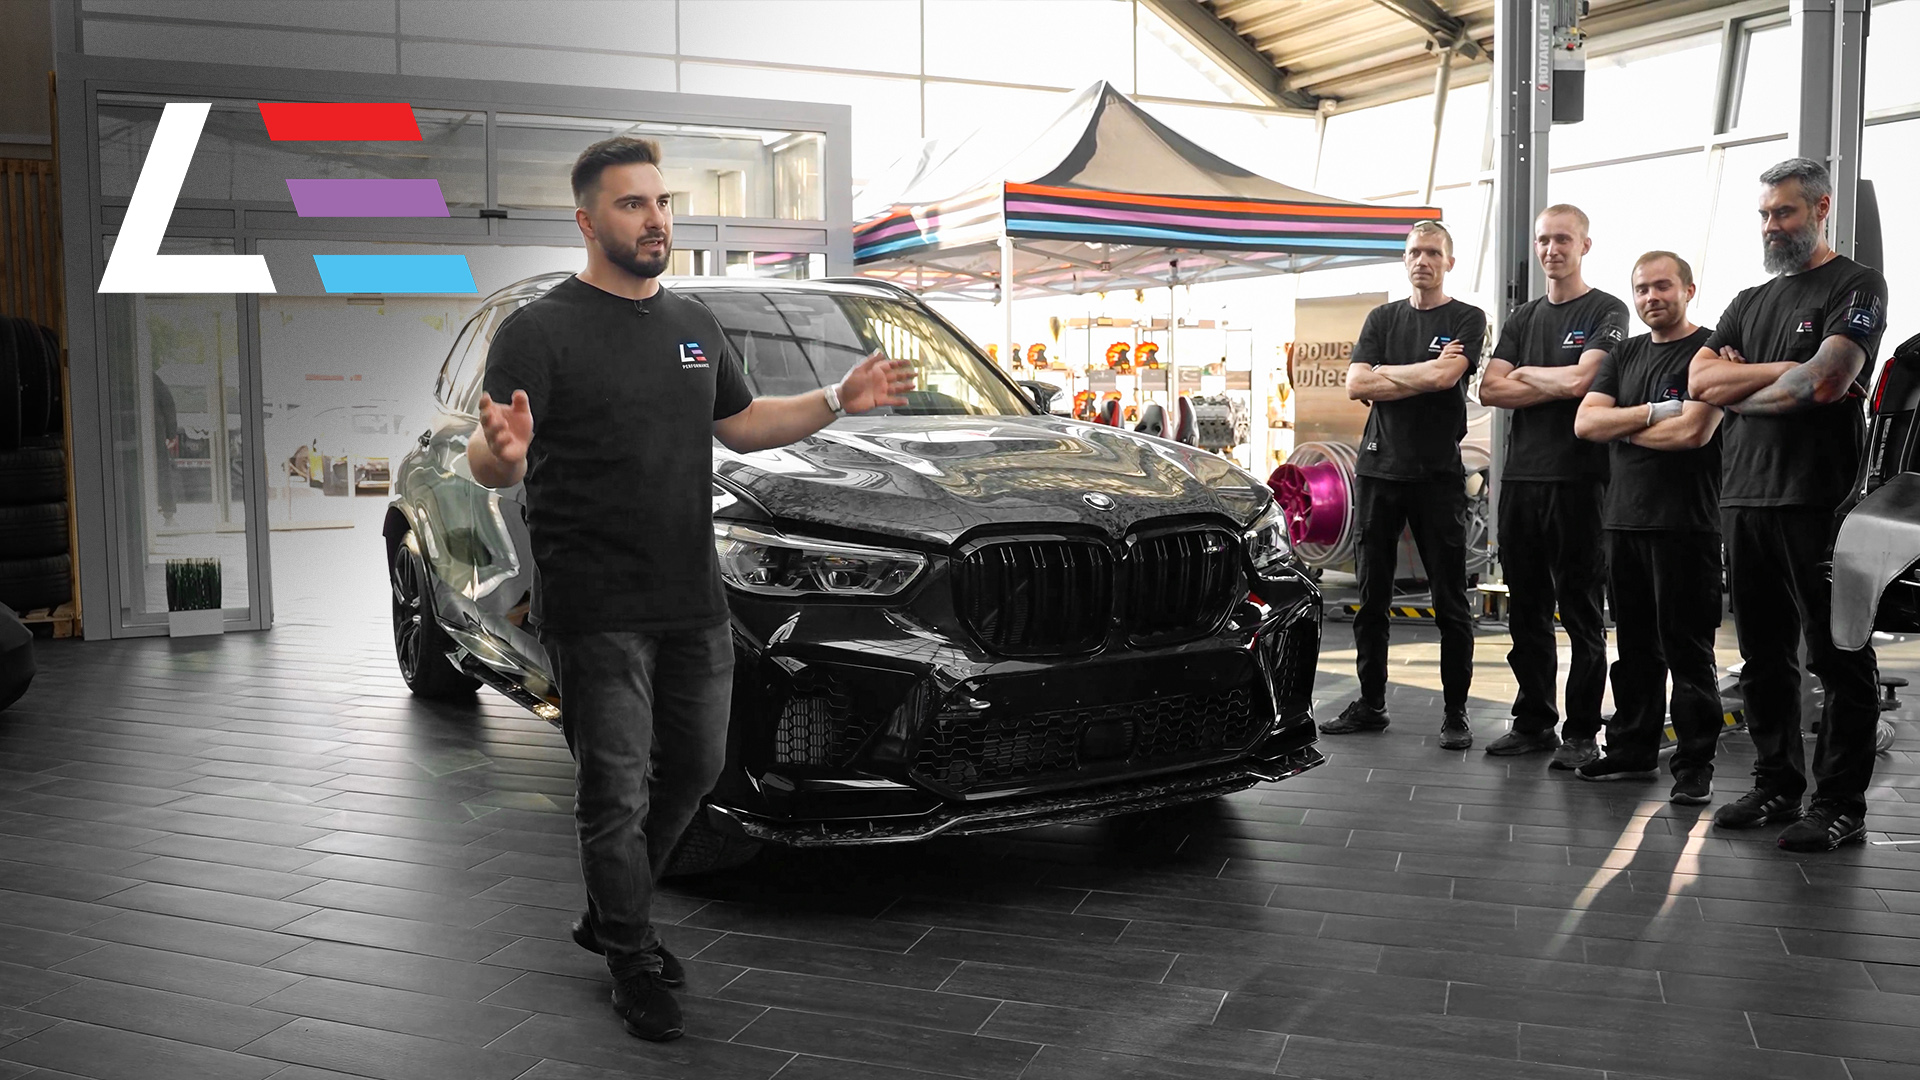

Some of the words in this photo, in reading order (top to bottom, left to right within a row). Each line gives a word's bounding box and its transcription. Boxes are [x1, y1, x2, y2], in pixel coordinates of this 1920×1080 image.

[1539, 3, 1550, 30] LIFT
[1538, 33, 1550, 84] ROTARY
[1296, 341, 1354, 366] powe
[1296, 363, 1347, 387] whee
